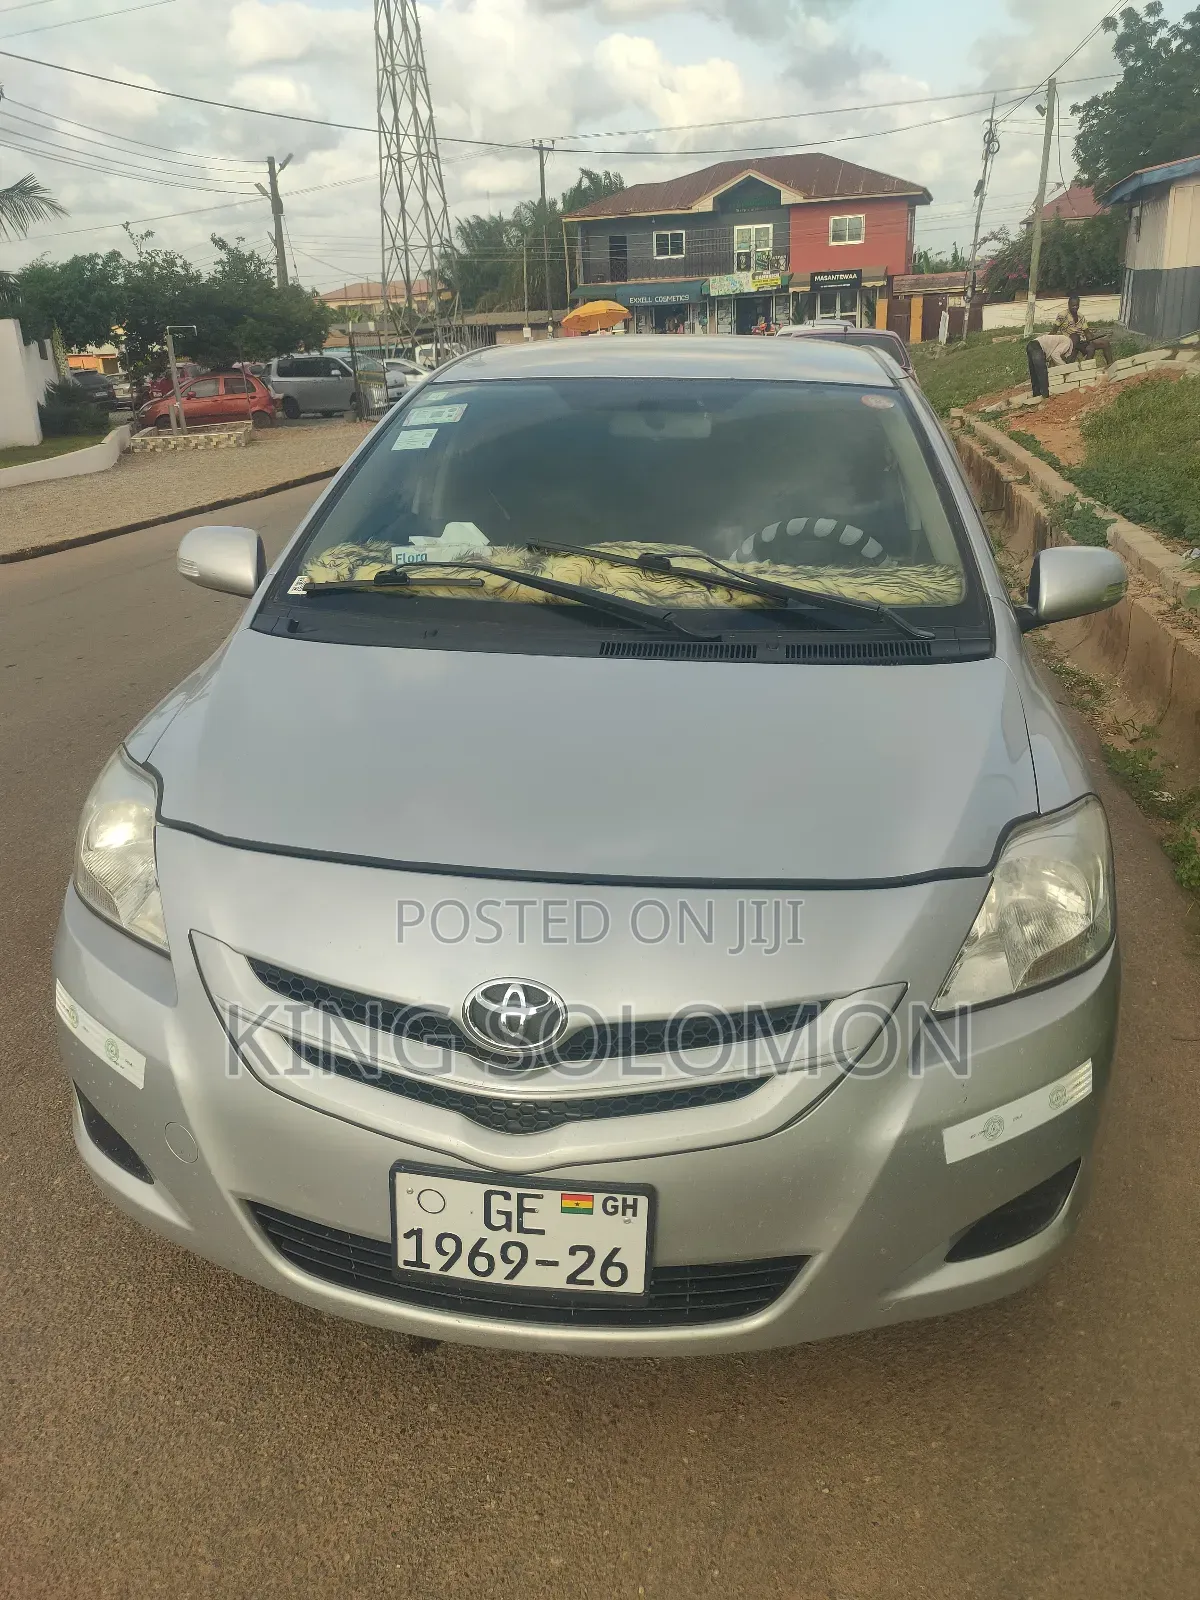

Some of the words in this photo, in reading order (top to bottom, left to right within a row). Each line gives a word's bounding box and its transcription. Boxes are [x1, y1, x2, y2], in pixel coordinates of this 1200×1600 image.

[654, 294, 690, 303] COSMETICS
[395, 552, 428, 564] Flora
[483, 1189, 546, 1235] GE
[601, 1195, 638, 1217] GH
[402, 1227, 629, 1288] 1969-26
